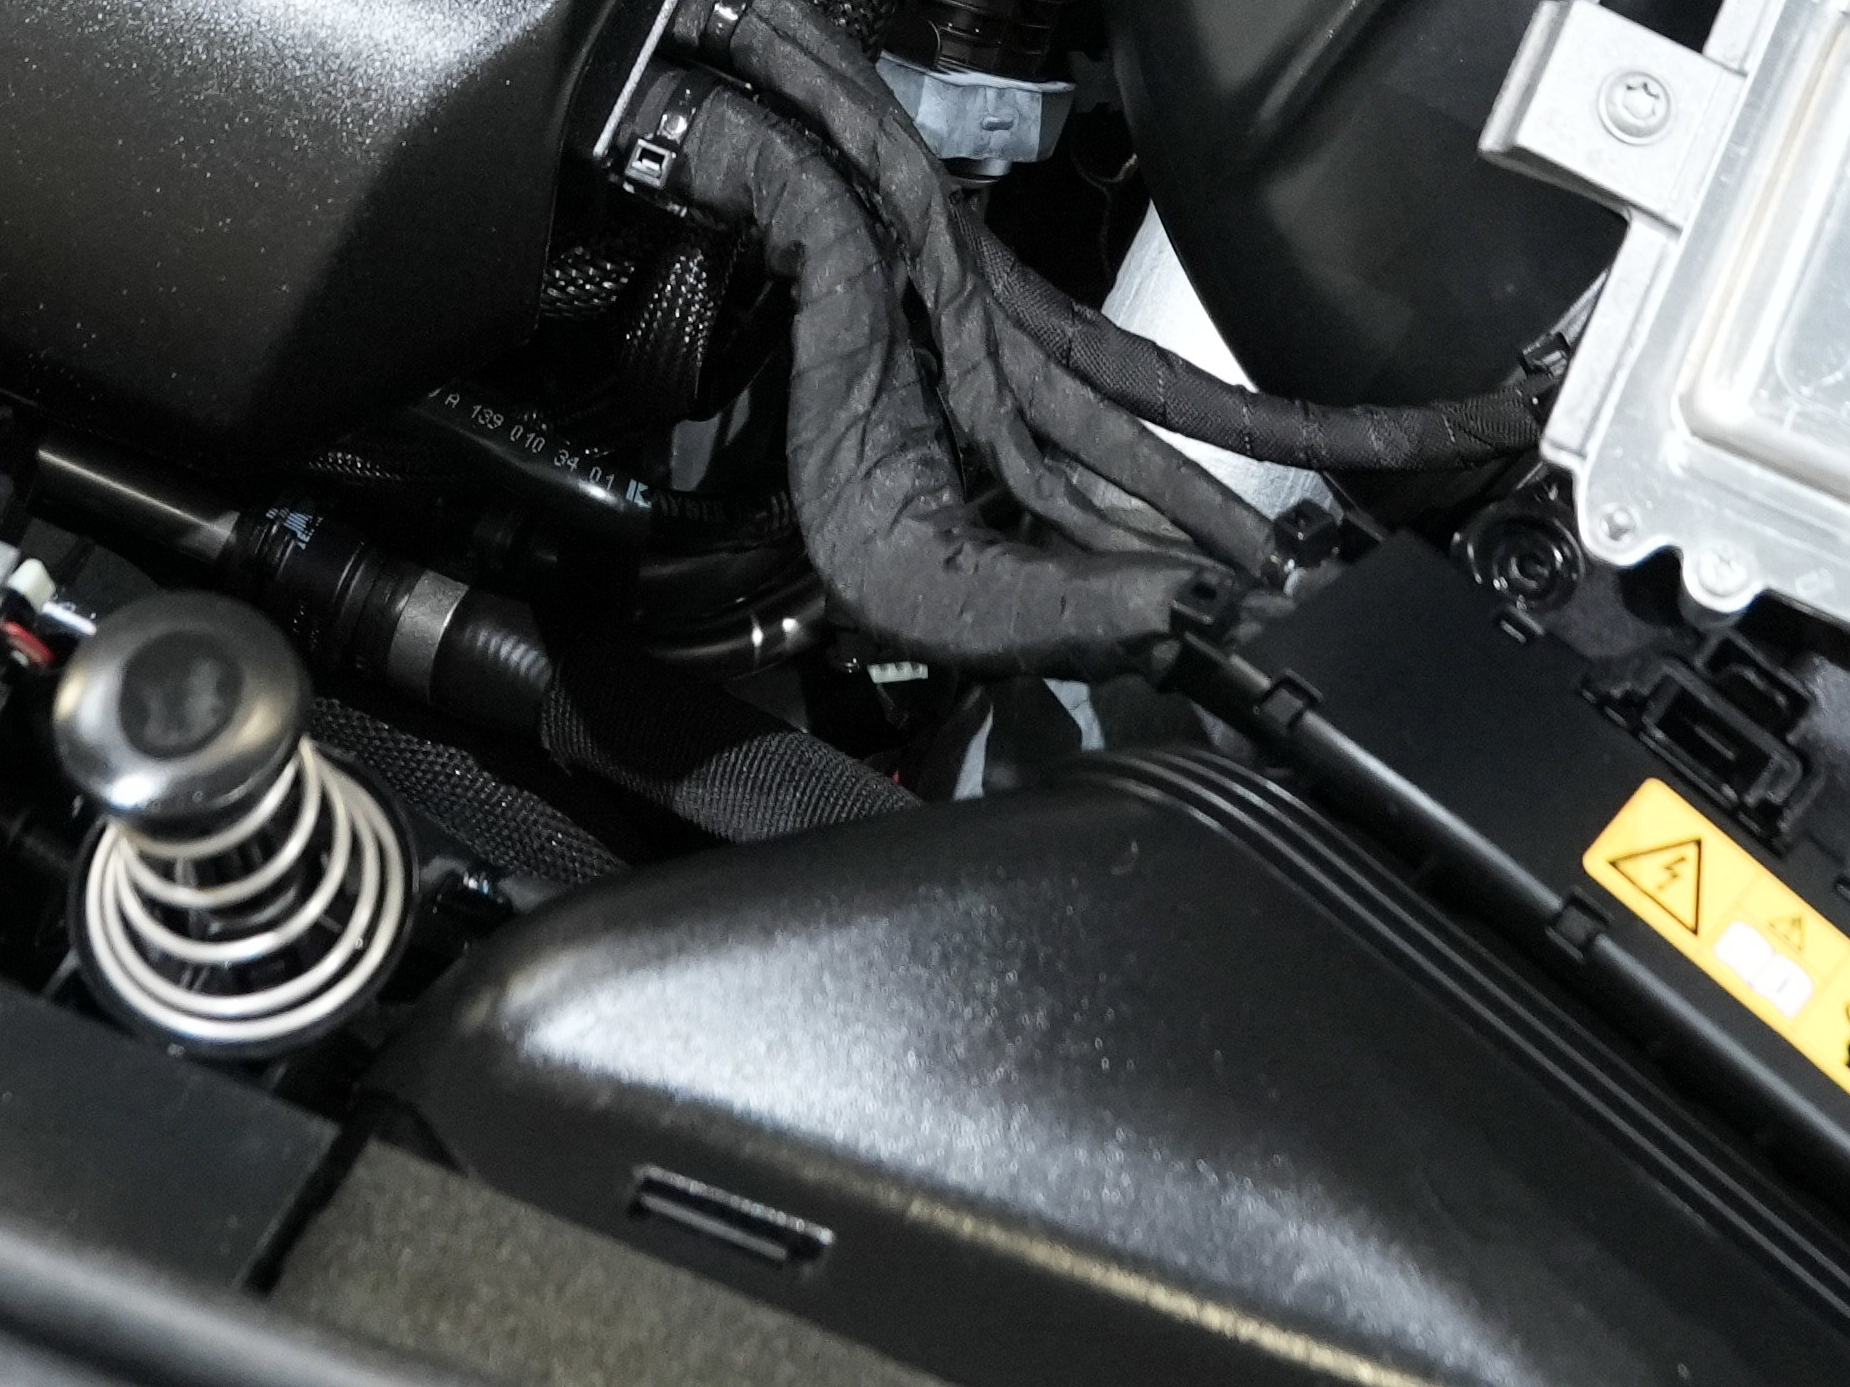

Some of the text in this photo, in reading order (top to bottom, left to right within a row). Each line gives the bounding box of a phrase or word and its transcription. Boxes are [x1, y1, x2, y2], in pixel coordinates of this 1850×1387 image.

[444, 392, 616, 492] A 139 010 34 01
